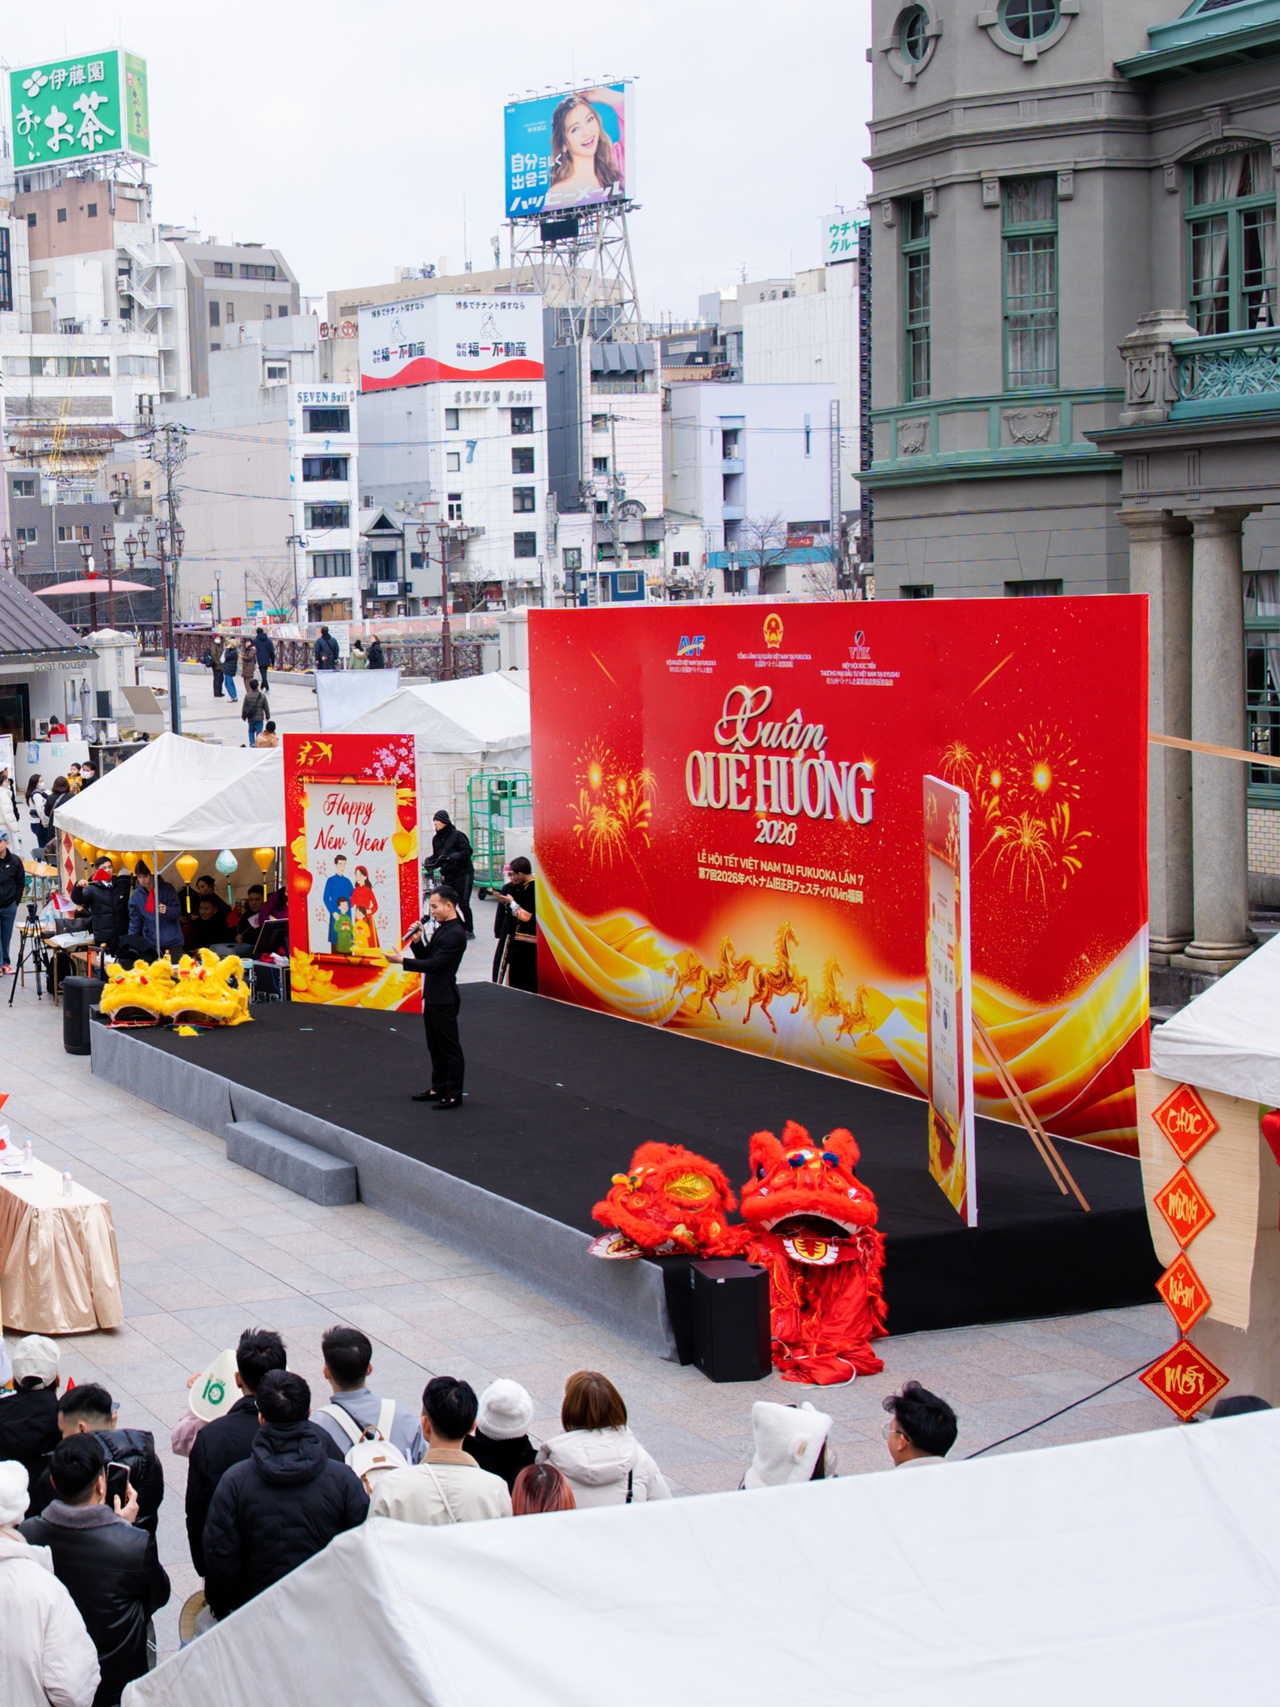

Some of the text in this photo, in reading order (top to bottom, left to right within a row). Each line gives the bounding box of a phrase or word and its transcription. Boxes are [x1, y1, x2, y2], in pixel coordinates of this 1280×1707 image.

[49, 60, 105, 91] 伊藤園
[44, 90, 116, 152] お茶
[468, 341, 527, 358] 福一不動産
[297, 391, 328, 403] SEVEN
[454, 390, 501, 404] SEVEN
[466, 440, 478, 463] 7
[35, 660, 87, 672] boat house
[714, 685, 828, 751] Xuân
[685, 741, 875, 824] QUÊ HƯƠNG
[323, 793, 376, 826] Happy
[313, 824, 389, 856] New Year
[754, 818, 798, 846] 2026
[697, 848, 707, 864] LỄ
[708, 852, 723, 868] HỘI
[723, 853, 739, 868] TẾT
[739, 856, 759, 872] VIỆT
[760, 860, 781, 874] NAM
[782, 863, 795, 878] TẠI
[796, 865, 838, 882] FUKUOKA
[857, 874, 864, 886] 7
[1166, 1105, 1203, 1135] CHÚC
[1168, 1272, 1196, 1312] NĂM
